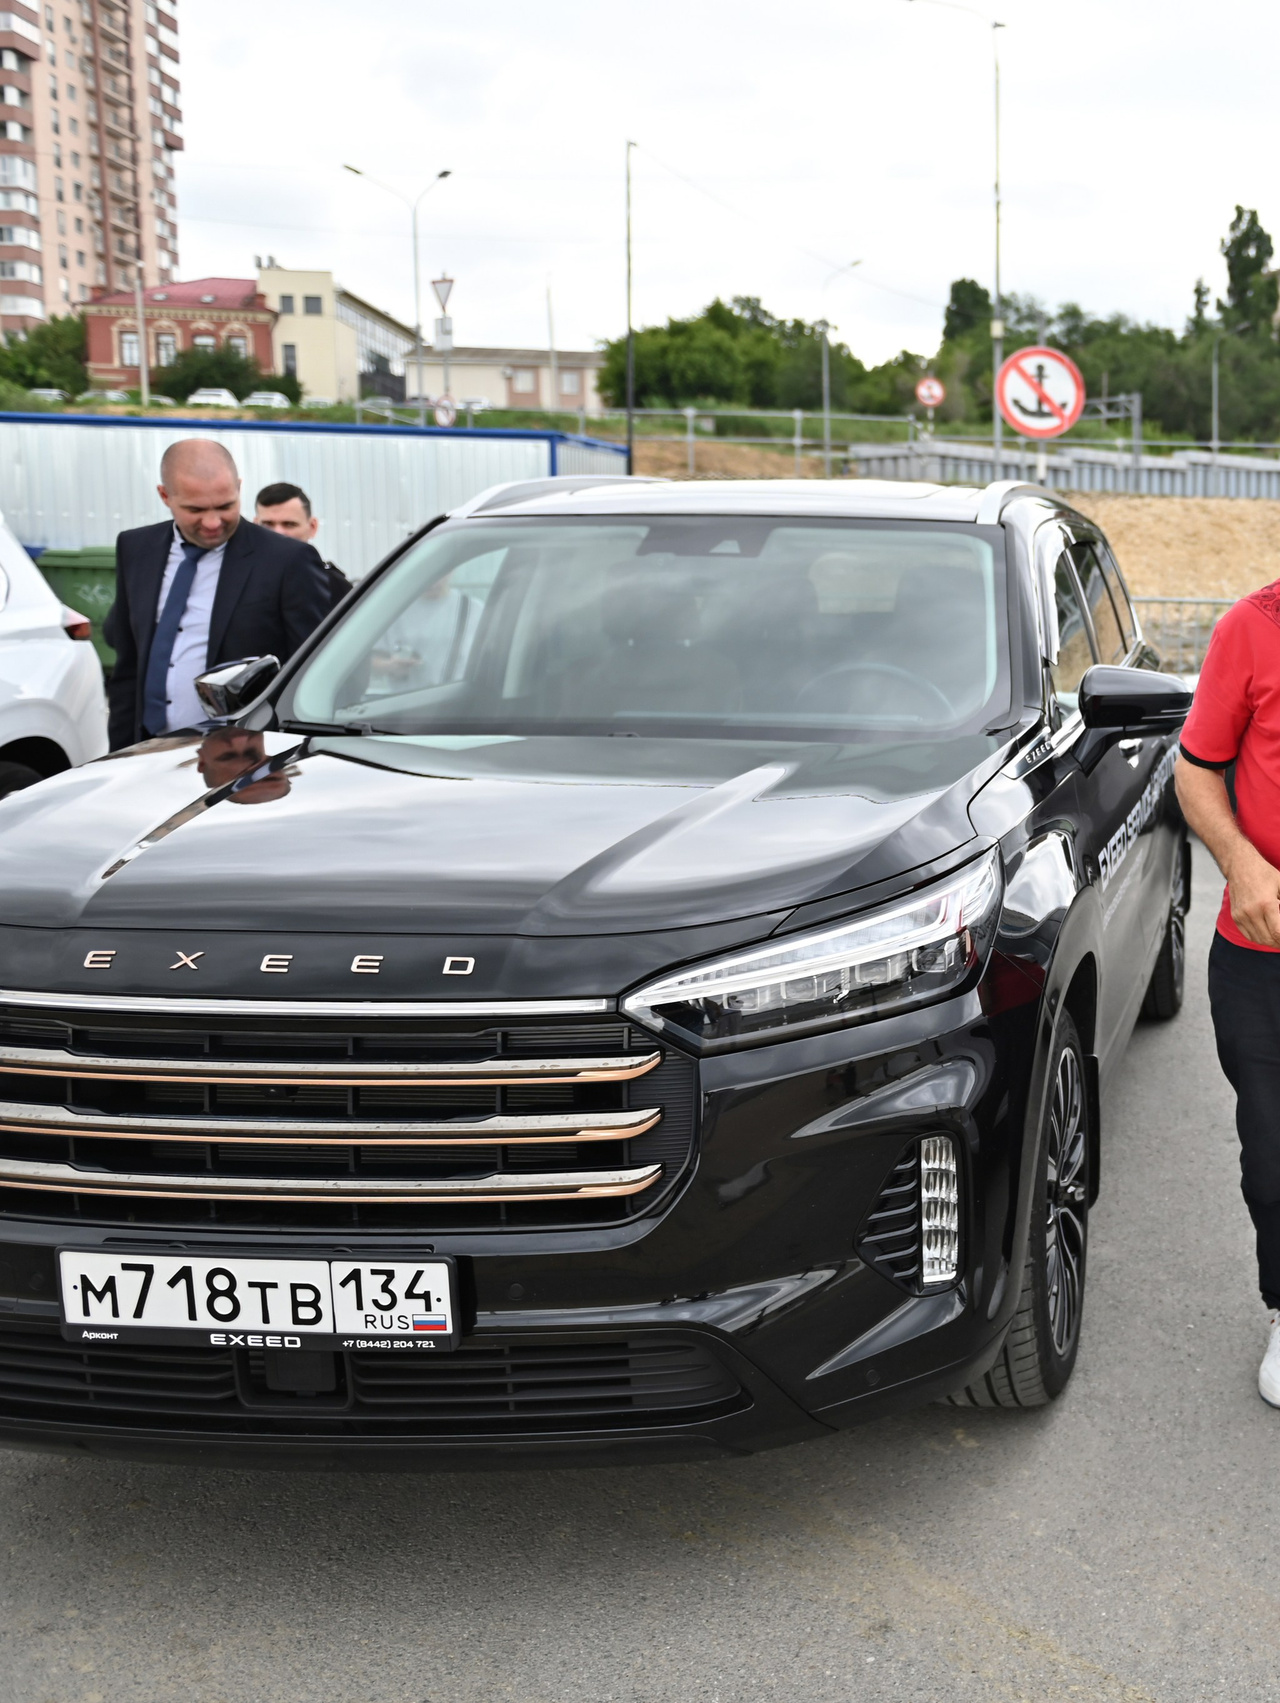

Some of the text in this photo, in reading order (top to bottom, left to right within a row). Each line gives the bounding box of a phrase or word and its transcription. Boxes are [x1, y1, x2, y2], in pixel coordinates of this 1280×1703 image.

[1098, 822, 1127, 893] EXEED
[1126, 783, 1152, 851] SERVICE
[82, 949, 476, 976] EXEED
[338, 1267, 433, 1313] 134
[364, 1313, 410, 1331] RUS
[82, 1330, 119, 1341] Арконт
[209, 1333, 302, 1349] EXEED
[342, 1339, 436, 1349] +7 (8442) 204 721
